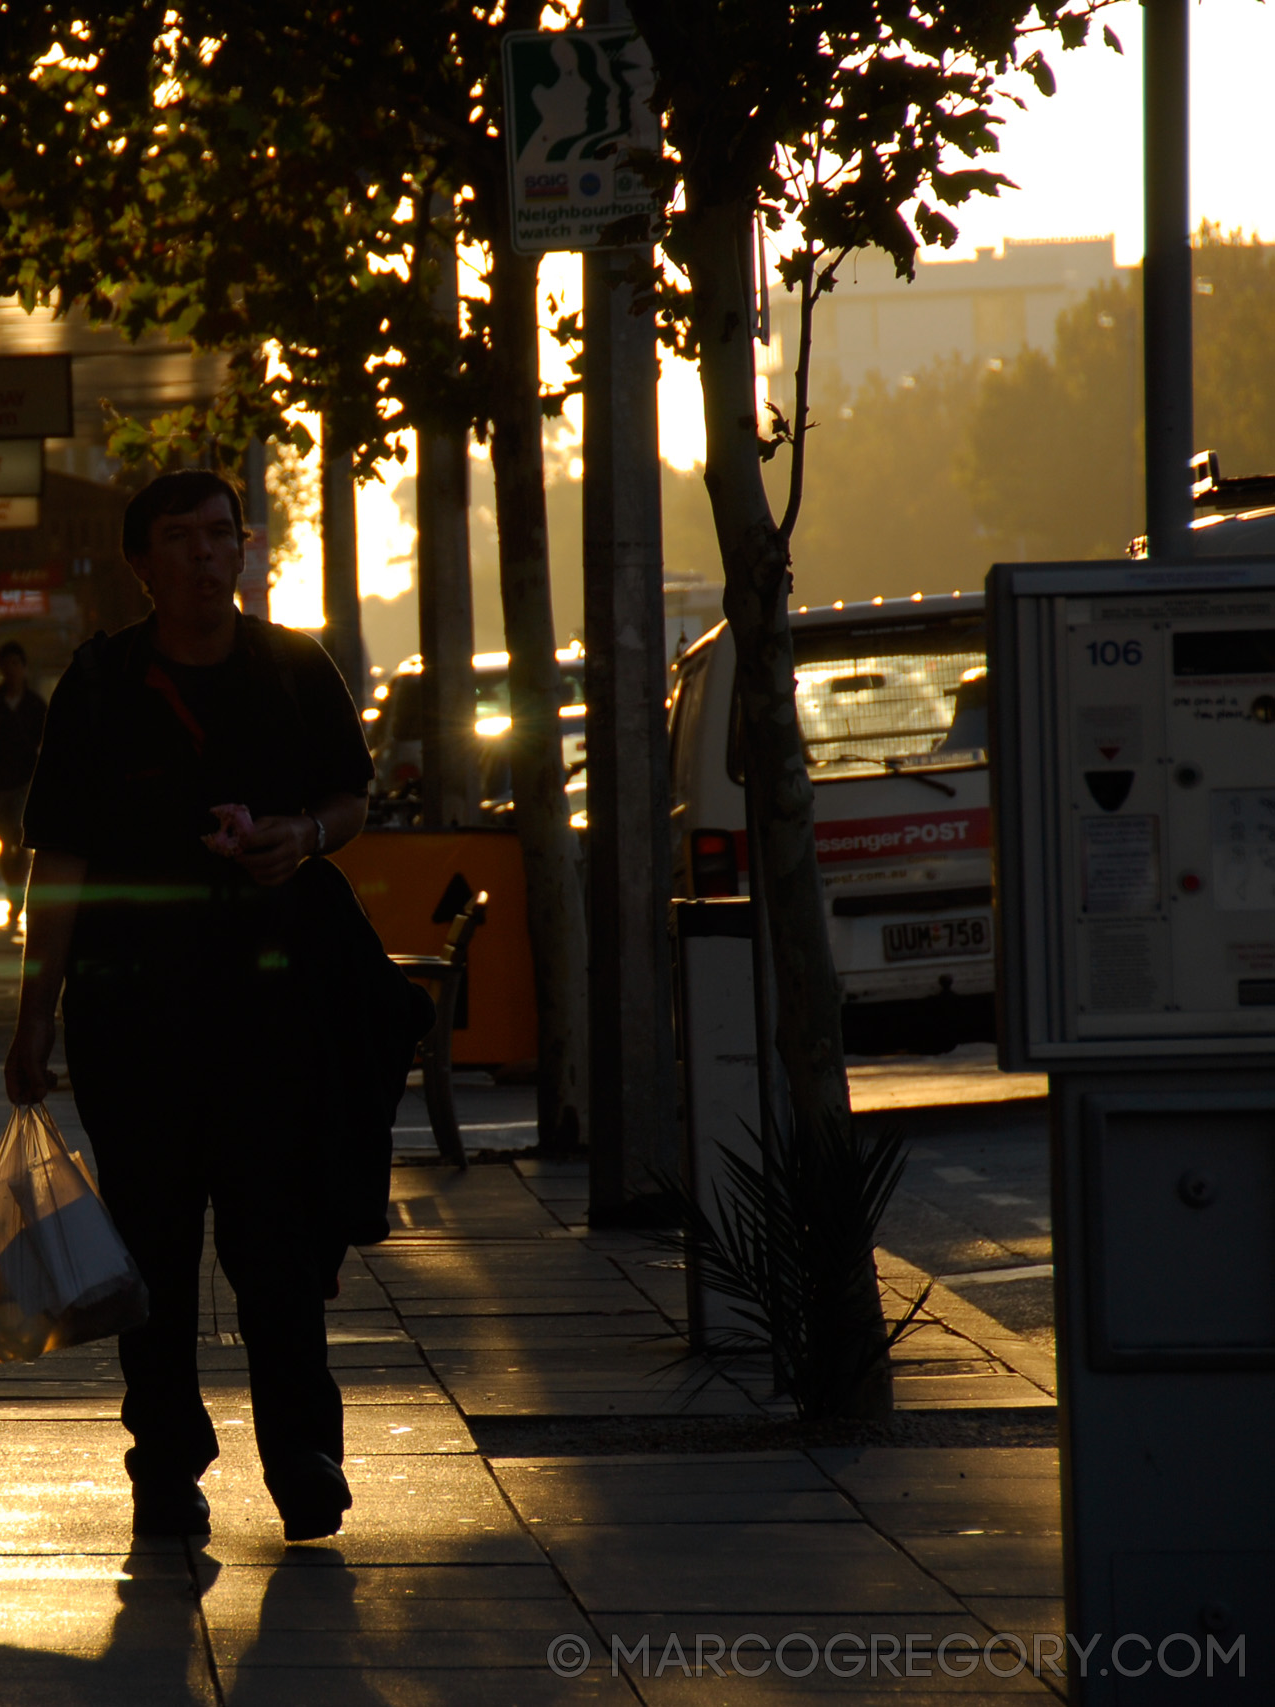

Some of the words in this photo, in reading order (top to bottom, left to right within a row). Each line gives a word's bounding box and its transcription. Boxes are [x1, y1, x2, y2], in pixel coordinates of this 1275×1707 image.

[518, 199, 658, 223] Neighbourhood
[518, 223, 571, 239] watch
[580, 221, 605, 235] are
[1086, 640, 1143, 666] 106
[815, 821, 970, 852] ssengerPOST
[822, 868, 907, 887] post.com.au
[889, 926, 932, 951] UUM
[943, 921, 984, 947] 758
